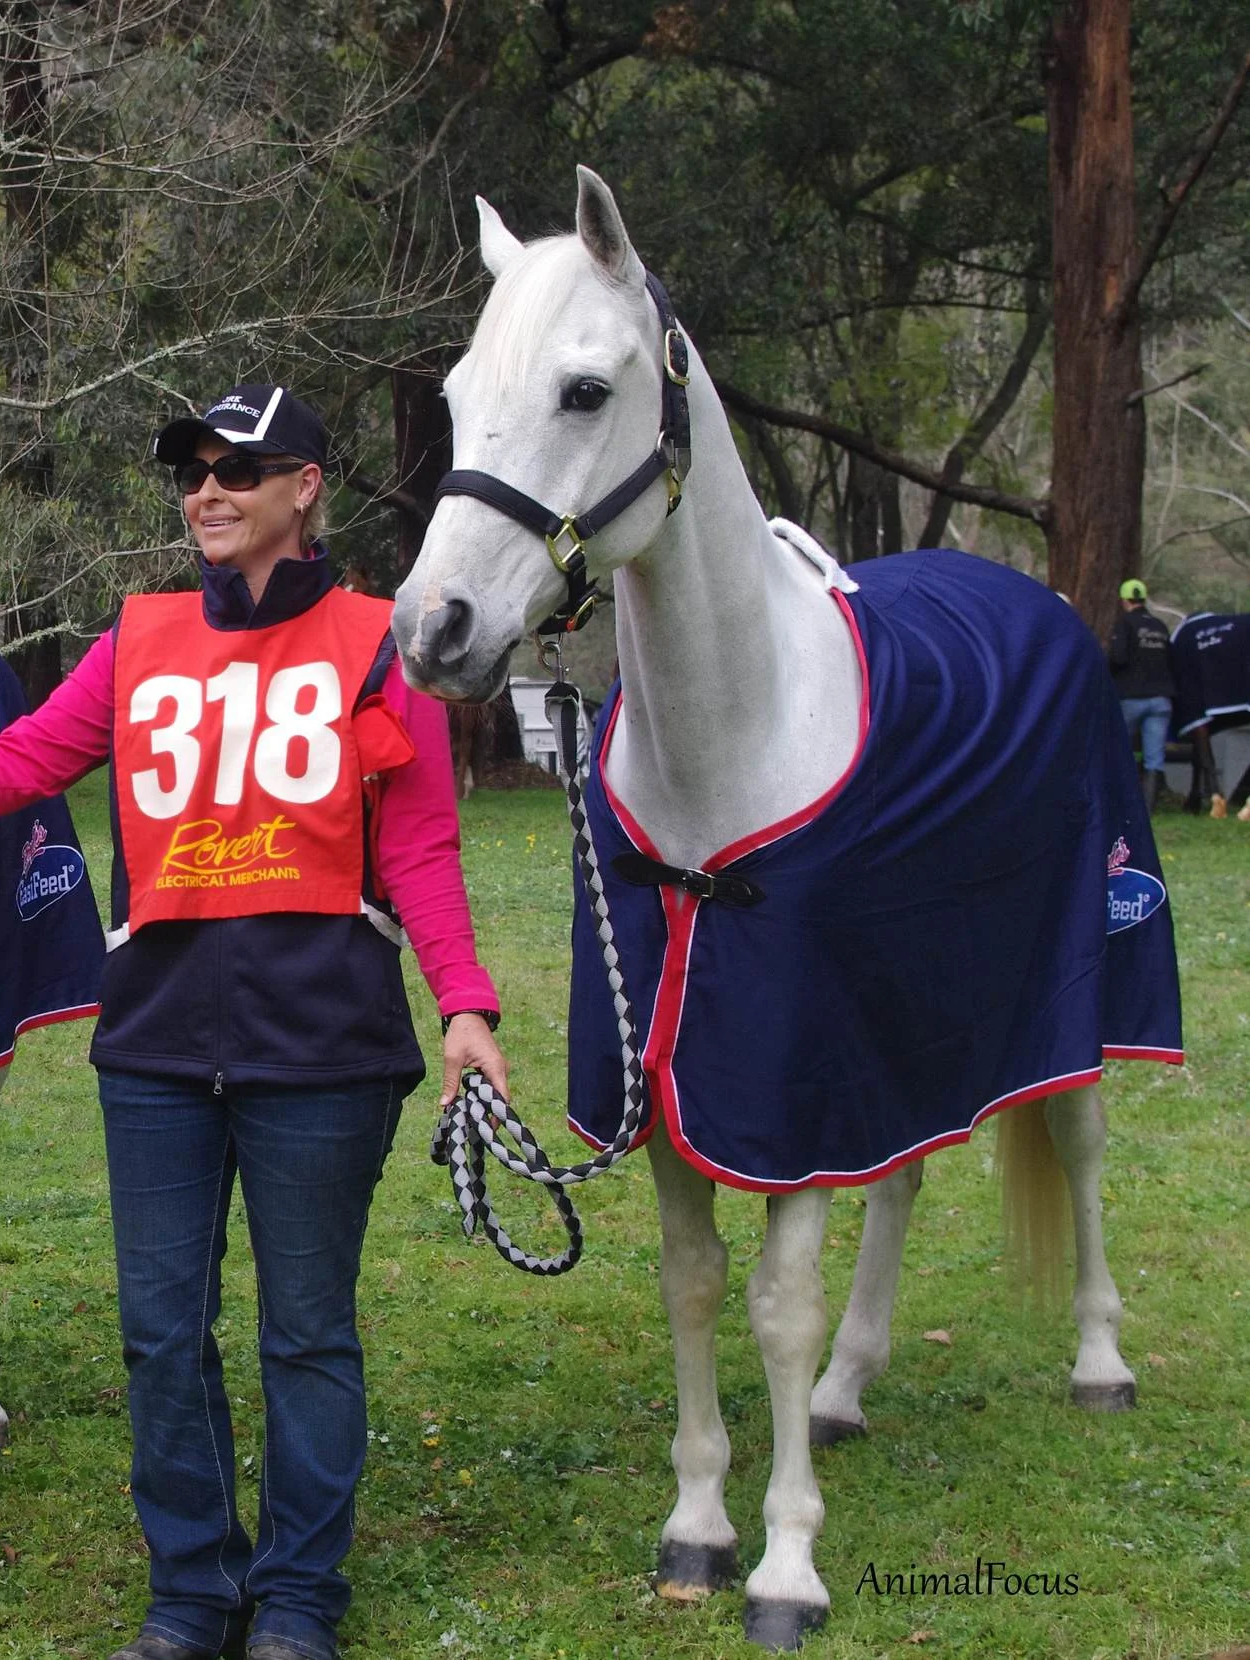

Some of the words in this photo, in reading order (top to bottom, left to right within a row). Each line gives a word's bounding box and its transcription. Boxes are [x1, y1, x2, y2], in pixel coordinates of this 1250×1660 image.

[204, 402, 261, 421] DURANCE
[129, 661, 342, 820] 318
[155, 874, 227, 889] ELECTRICAL
[229, 867, 300, 886] MERCHANTS
